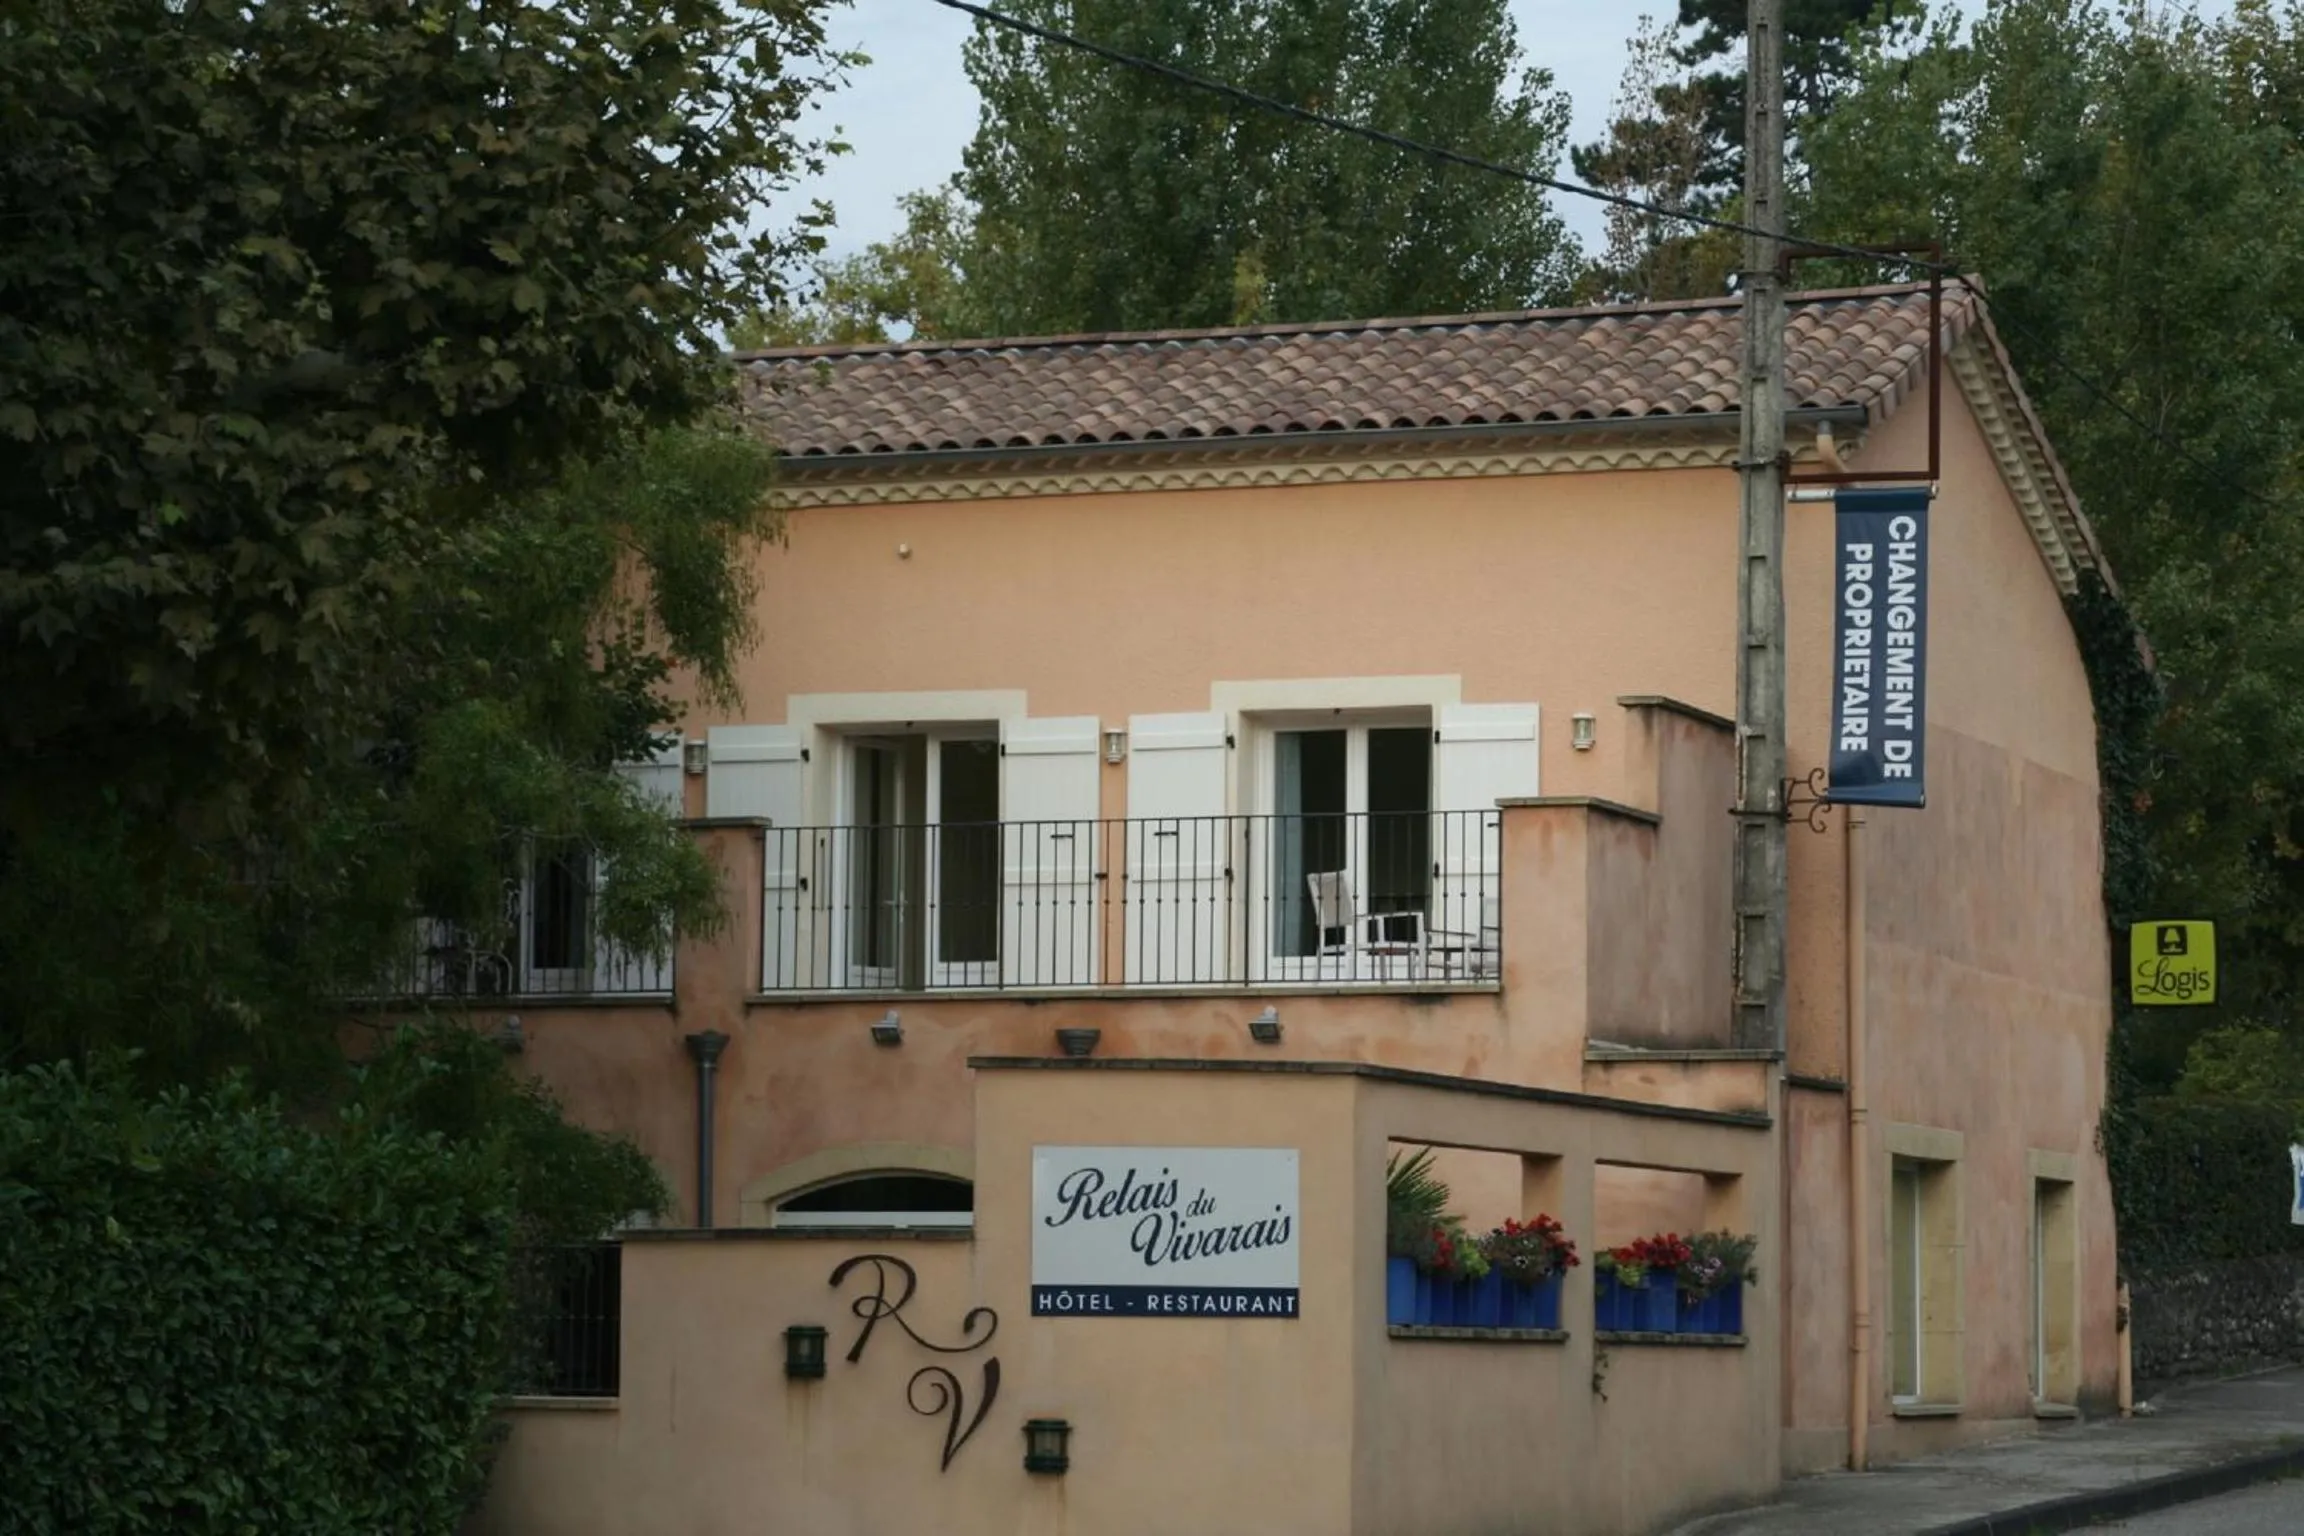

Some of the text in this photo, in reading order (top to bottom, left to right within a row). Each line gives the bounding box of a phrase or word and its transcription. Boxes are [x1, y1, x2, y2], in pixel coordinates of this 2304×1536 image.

[1840, 542, 1873, 752] PROPRIETAIRE
[1883, 514, 1917, 778] CHANGEMENT DE
[2134, 954, 2211, 1000] Logis
[1044, 1166, 1217, 1228] Relais du
[1130, 1203, 1292, 1267] Vivarais
[1038, 1289, 1115, 1311] HÔTEL
[1147, 1294, 1296, 1313] RESTAURANT
